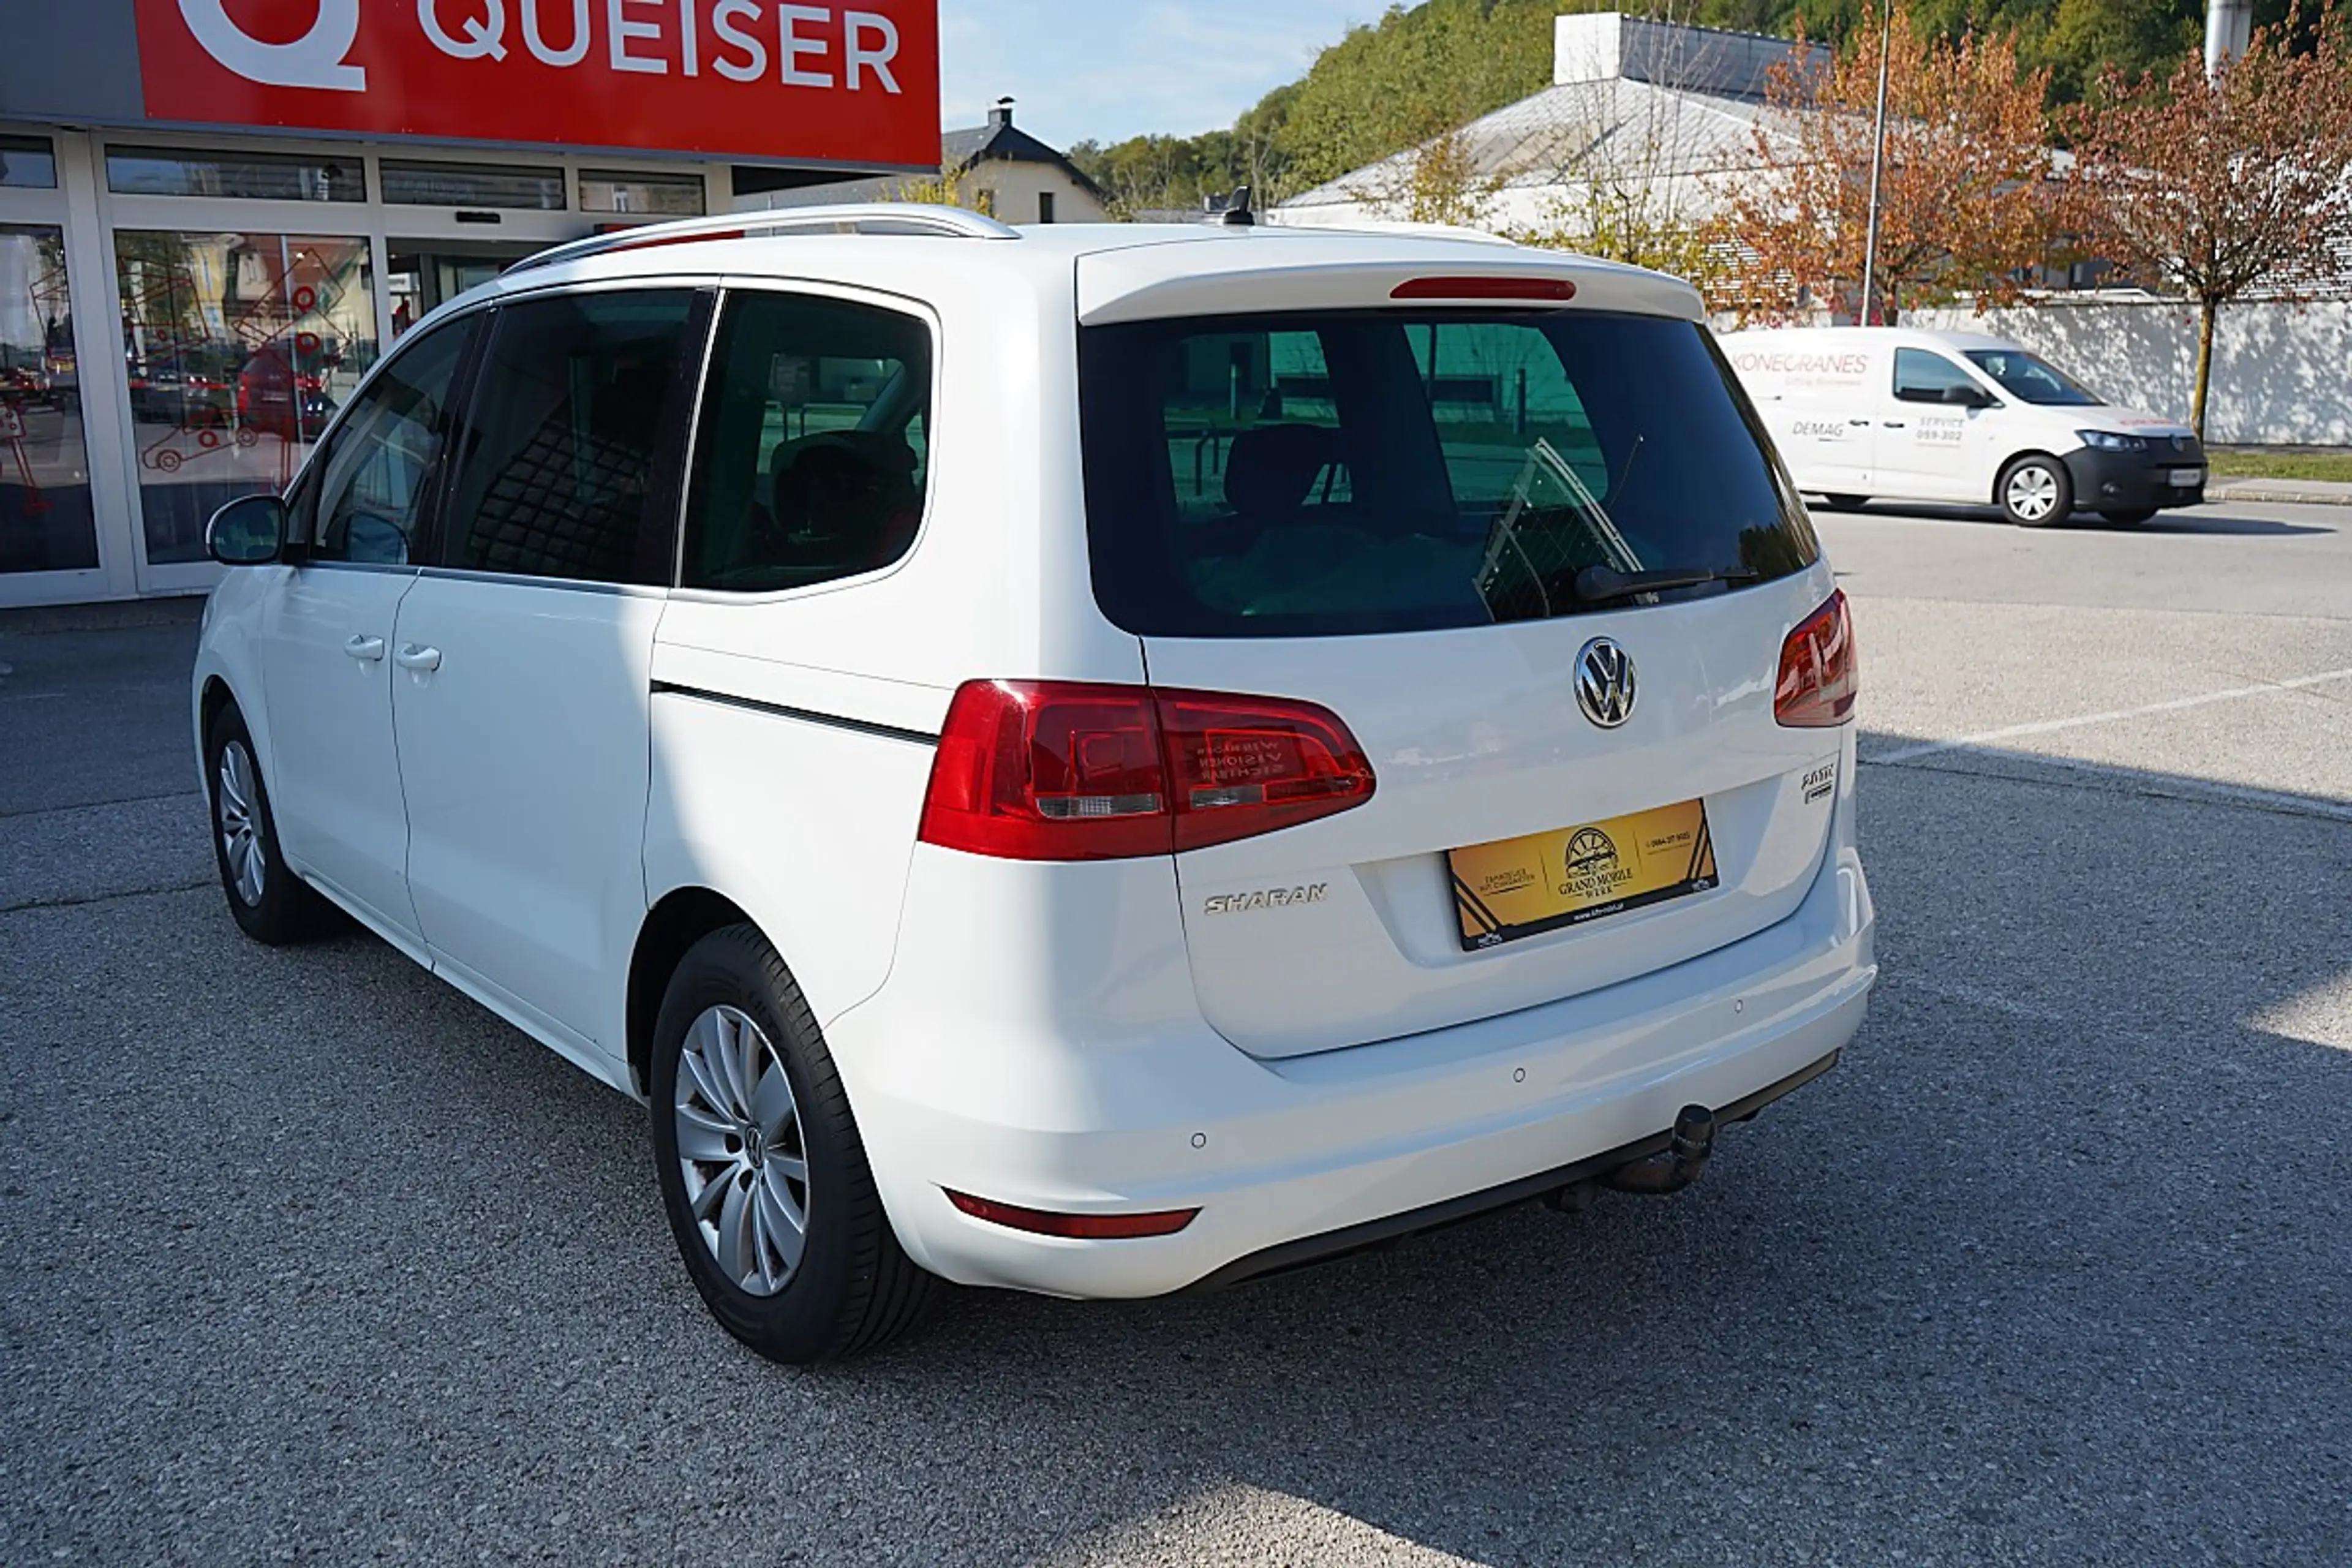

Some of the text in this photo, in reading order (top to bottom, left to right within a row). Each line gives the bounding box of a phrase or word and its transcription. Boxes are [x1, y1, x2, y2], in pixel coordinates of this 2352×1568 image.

[417, 0, 903, 94] QUEISER
[1732, 352, 1869, 374] KONECRANES
[1792, 420, 1844, 437] DEMAG
[1558, 876, 1597, 897] GRAND
[1204, 882, 1330, 915] SHARAN
